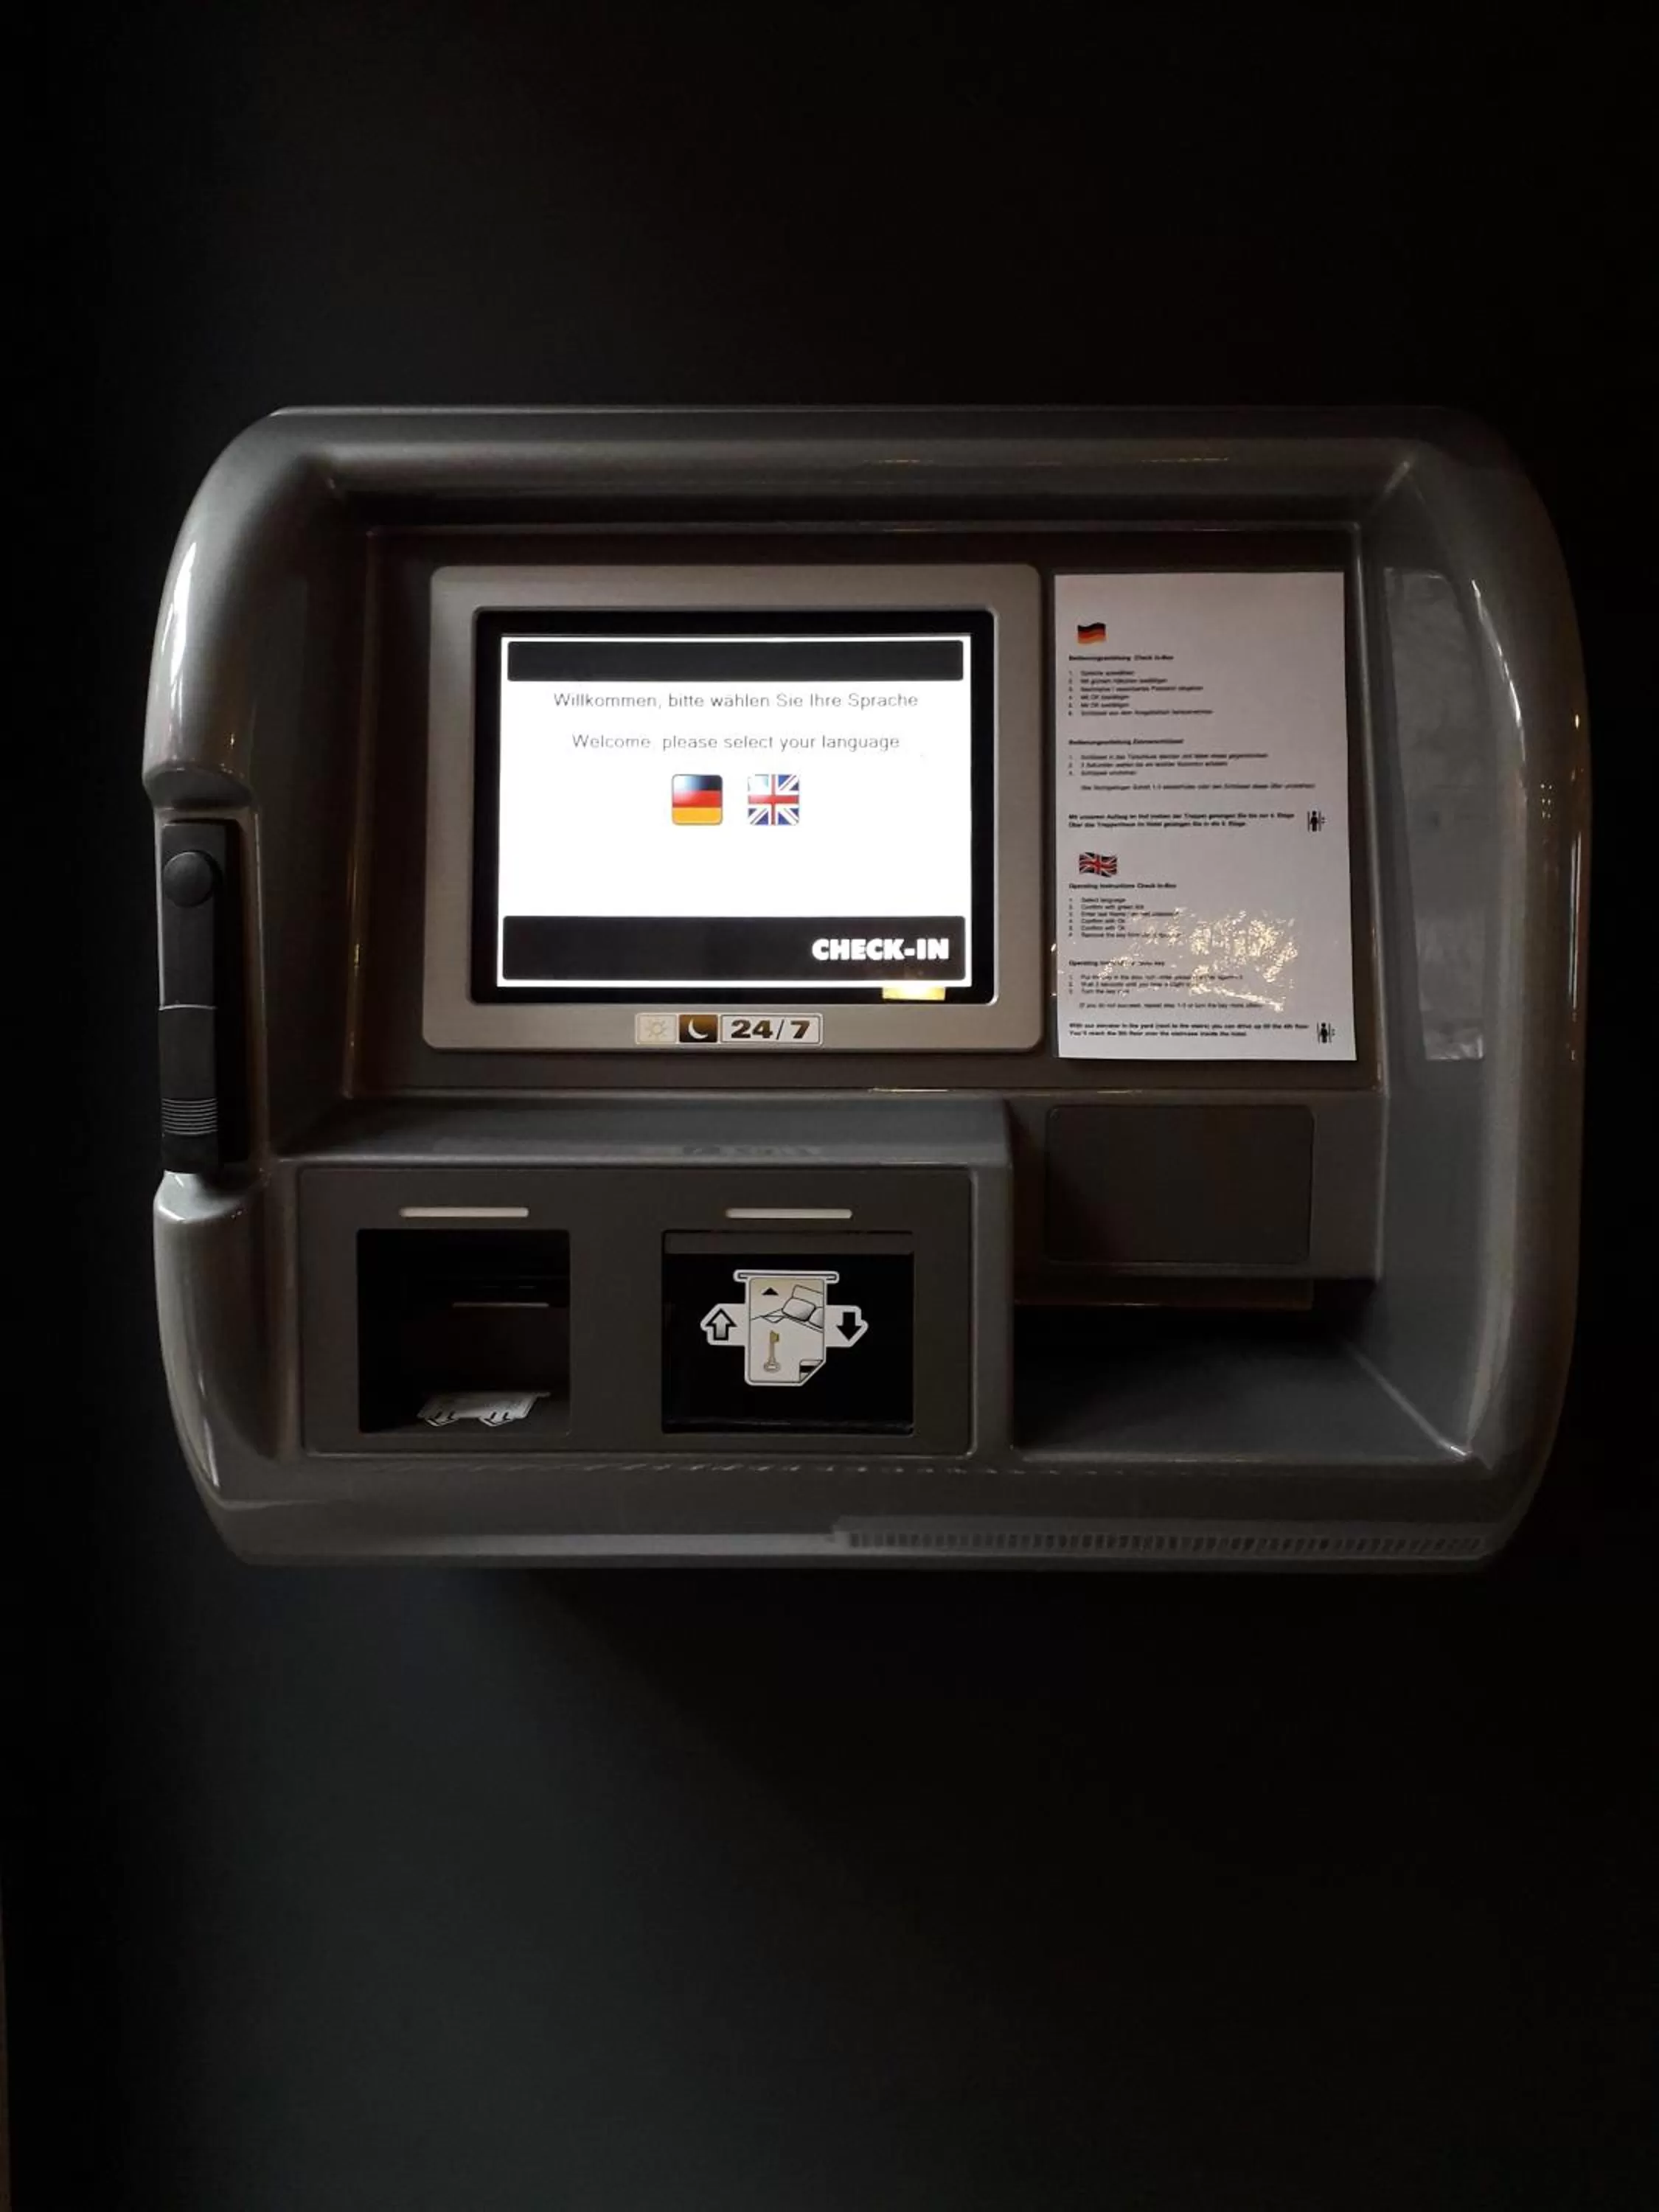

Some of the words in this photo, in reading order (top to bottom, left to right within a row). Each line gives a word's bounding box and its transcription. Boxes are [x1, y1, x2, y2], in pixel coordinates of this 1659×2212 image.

[554, 693, 661, 709] Willkommen,
[668, 694, 704, 707] bitte
[776, 692, 803, 707] Sie
[810, 693, 841, 707] Ihre
[848, 692, 919, 710] Sprache
[663, 734, 717, 752] please
[723, 735, 773, 748] select
[779, 737, 815, 752] your
[822, 735, 900, 753] language
[812, 939, 950, 961] CHECK-IN
[731, 1019, 810, 1040] 24/7
